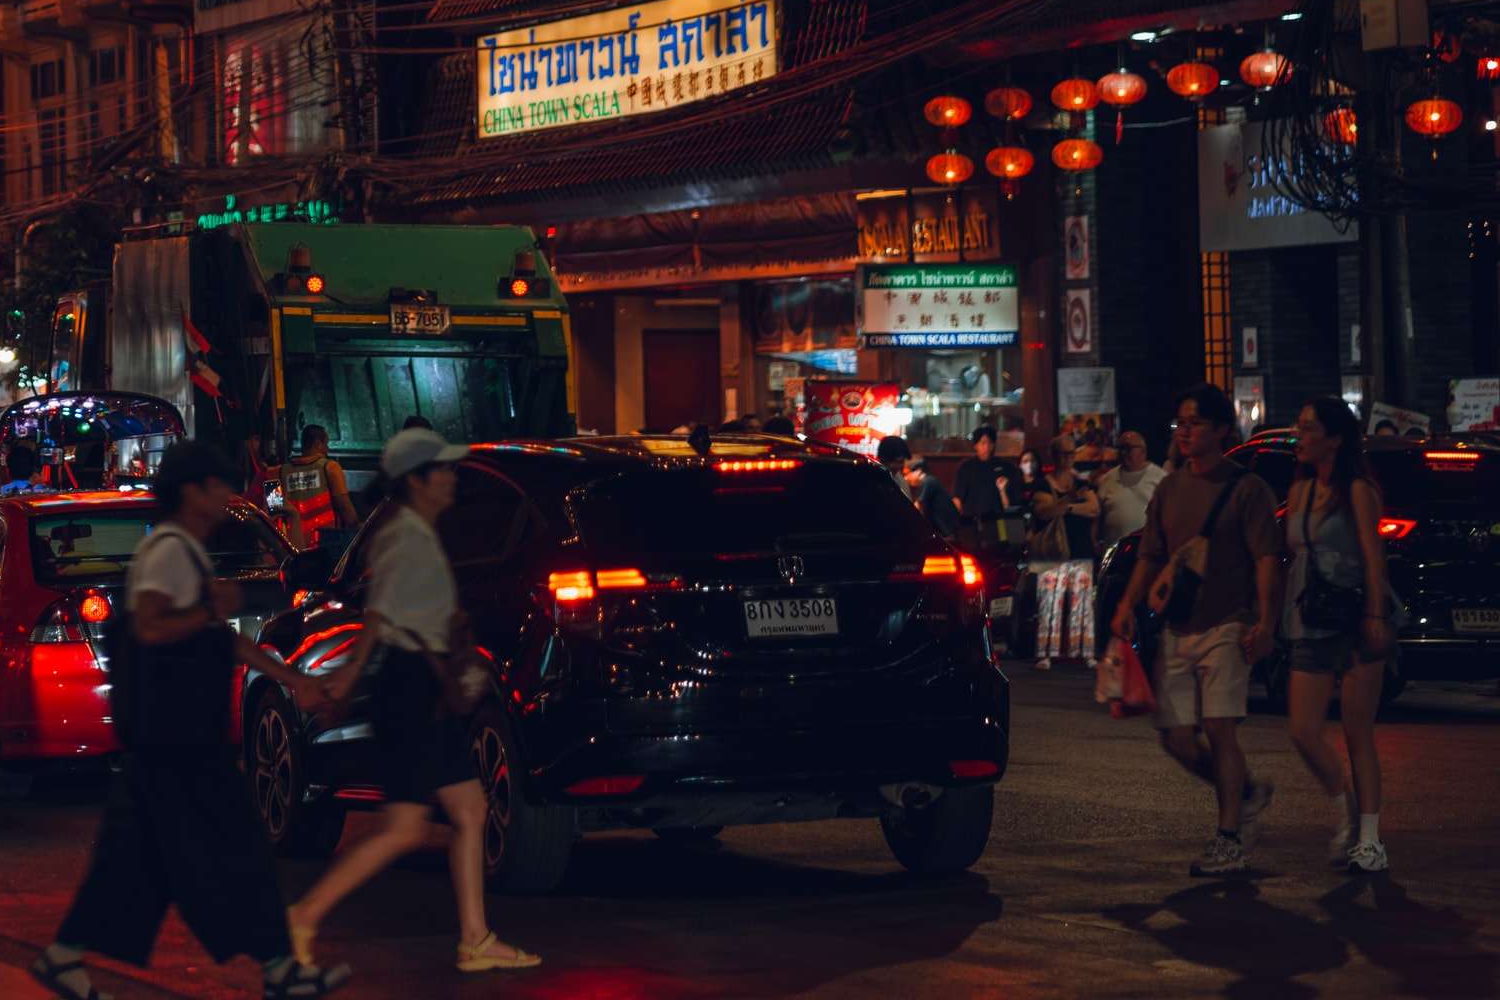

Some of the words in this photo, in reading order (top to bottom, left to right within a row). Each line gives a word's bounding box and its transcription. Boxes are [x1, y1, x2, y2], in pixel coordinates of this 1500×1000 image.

[484, 12, 641, 97] ไชน่าทาวน์
[484, 107, 524, 134] CHINA
[529, 97, 569, 127] TOWN
[573, 89, 621, 122] SCALA
[789, 600, 833, 618] 3508
